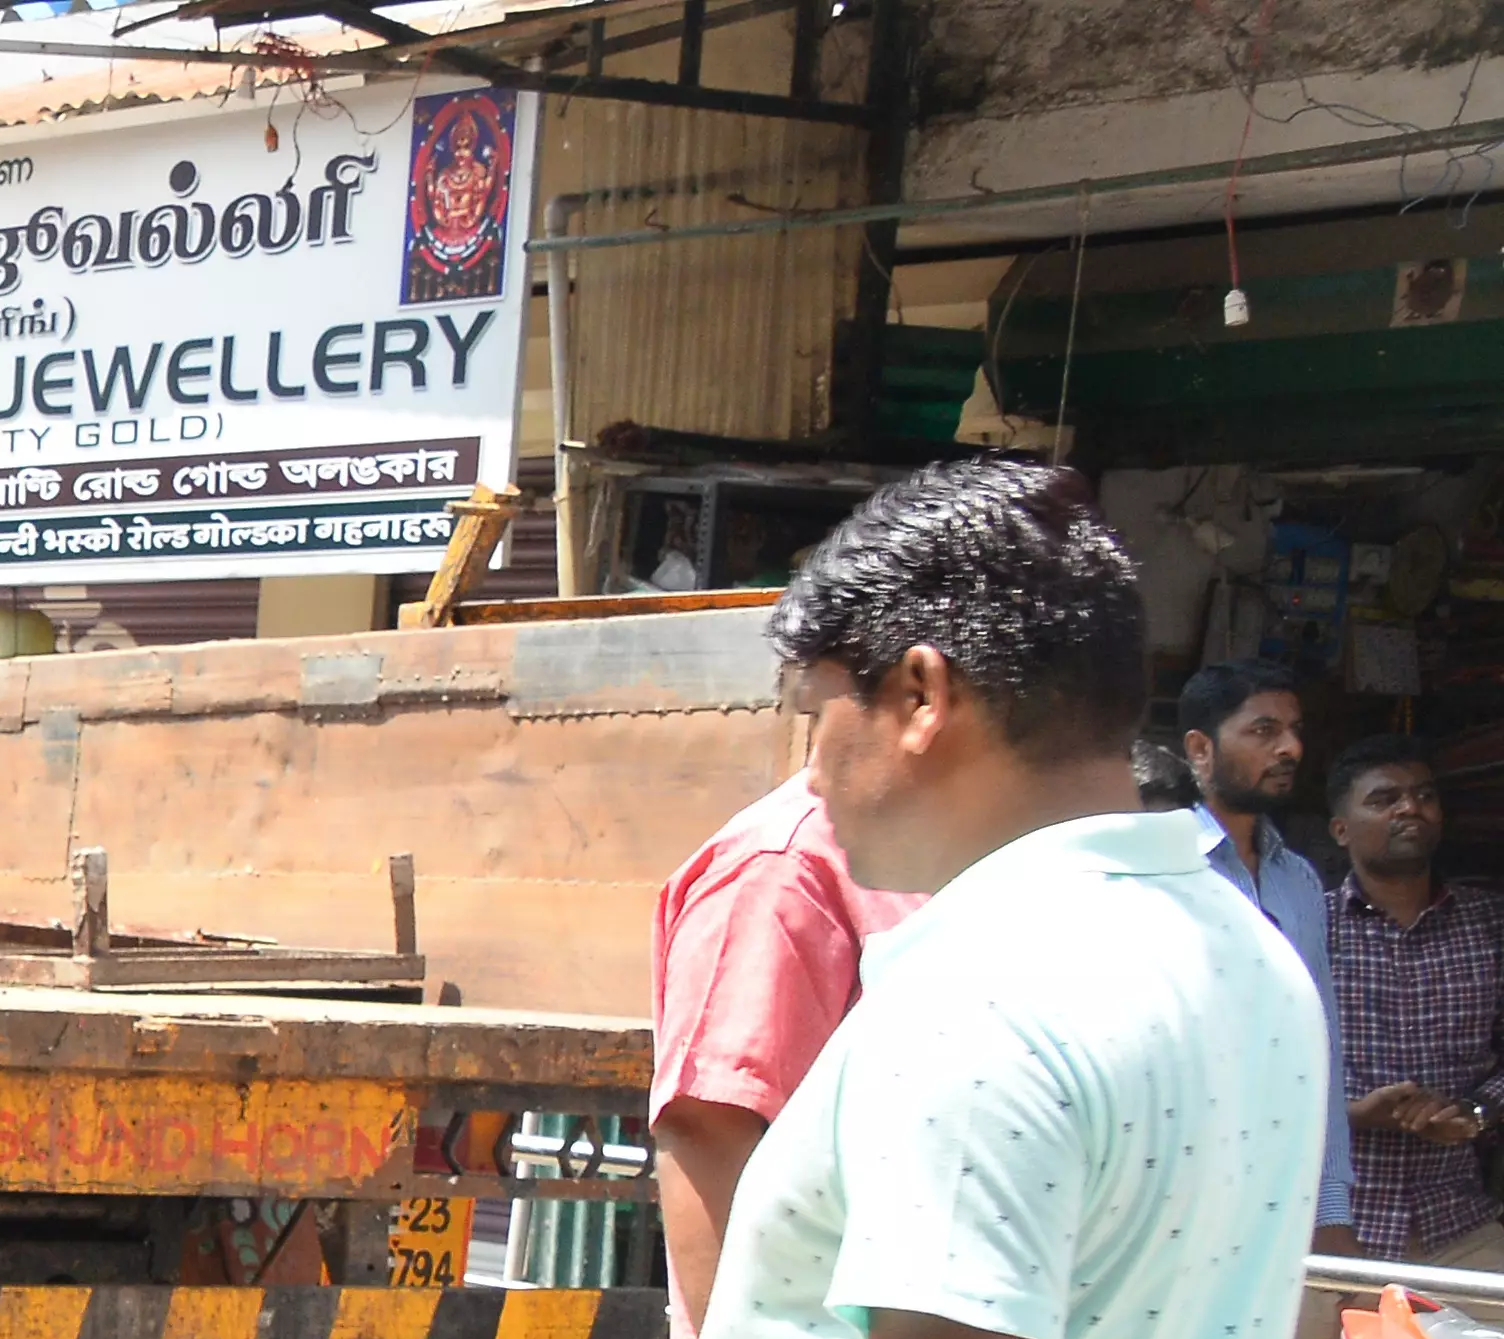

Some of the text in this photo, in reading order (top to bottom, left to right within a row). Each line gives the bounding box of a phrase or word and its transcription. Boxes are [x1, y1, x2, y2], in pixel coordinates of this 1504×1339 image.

[75, 411, 225, 448] GOLD)
[212, 1118, 392, 1178] HORN
[388, 1247, 456, 1288] 794
